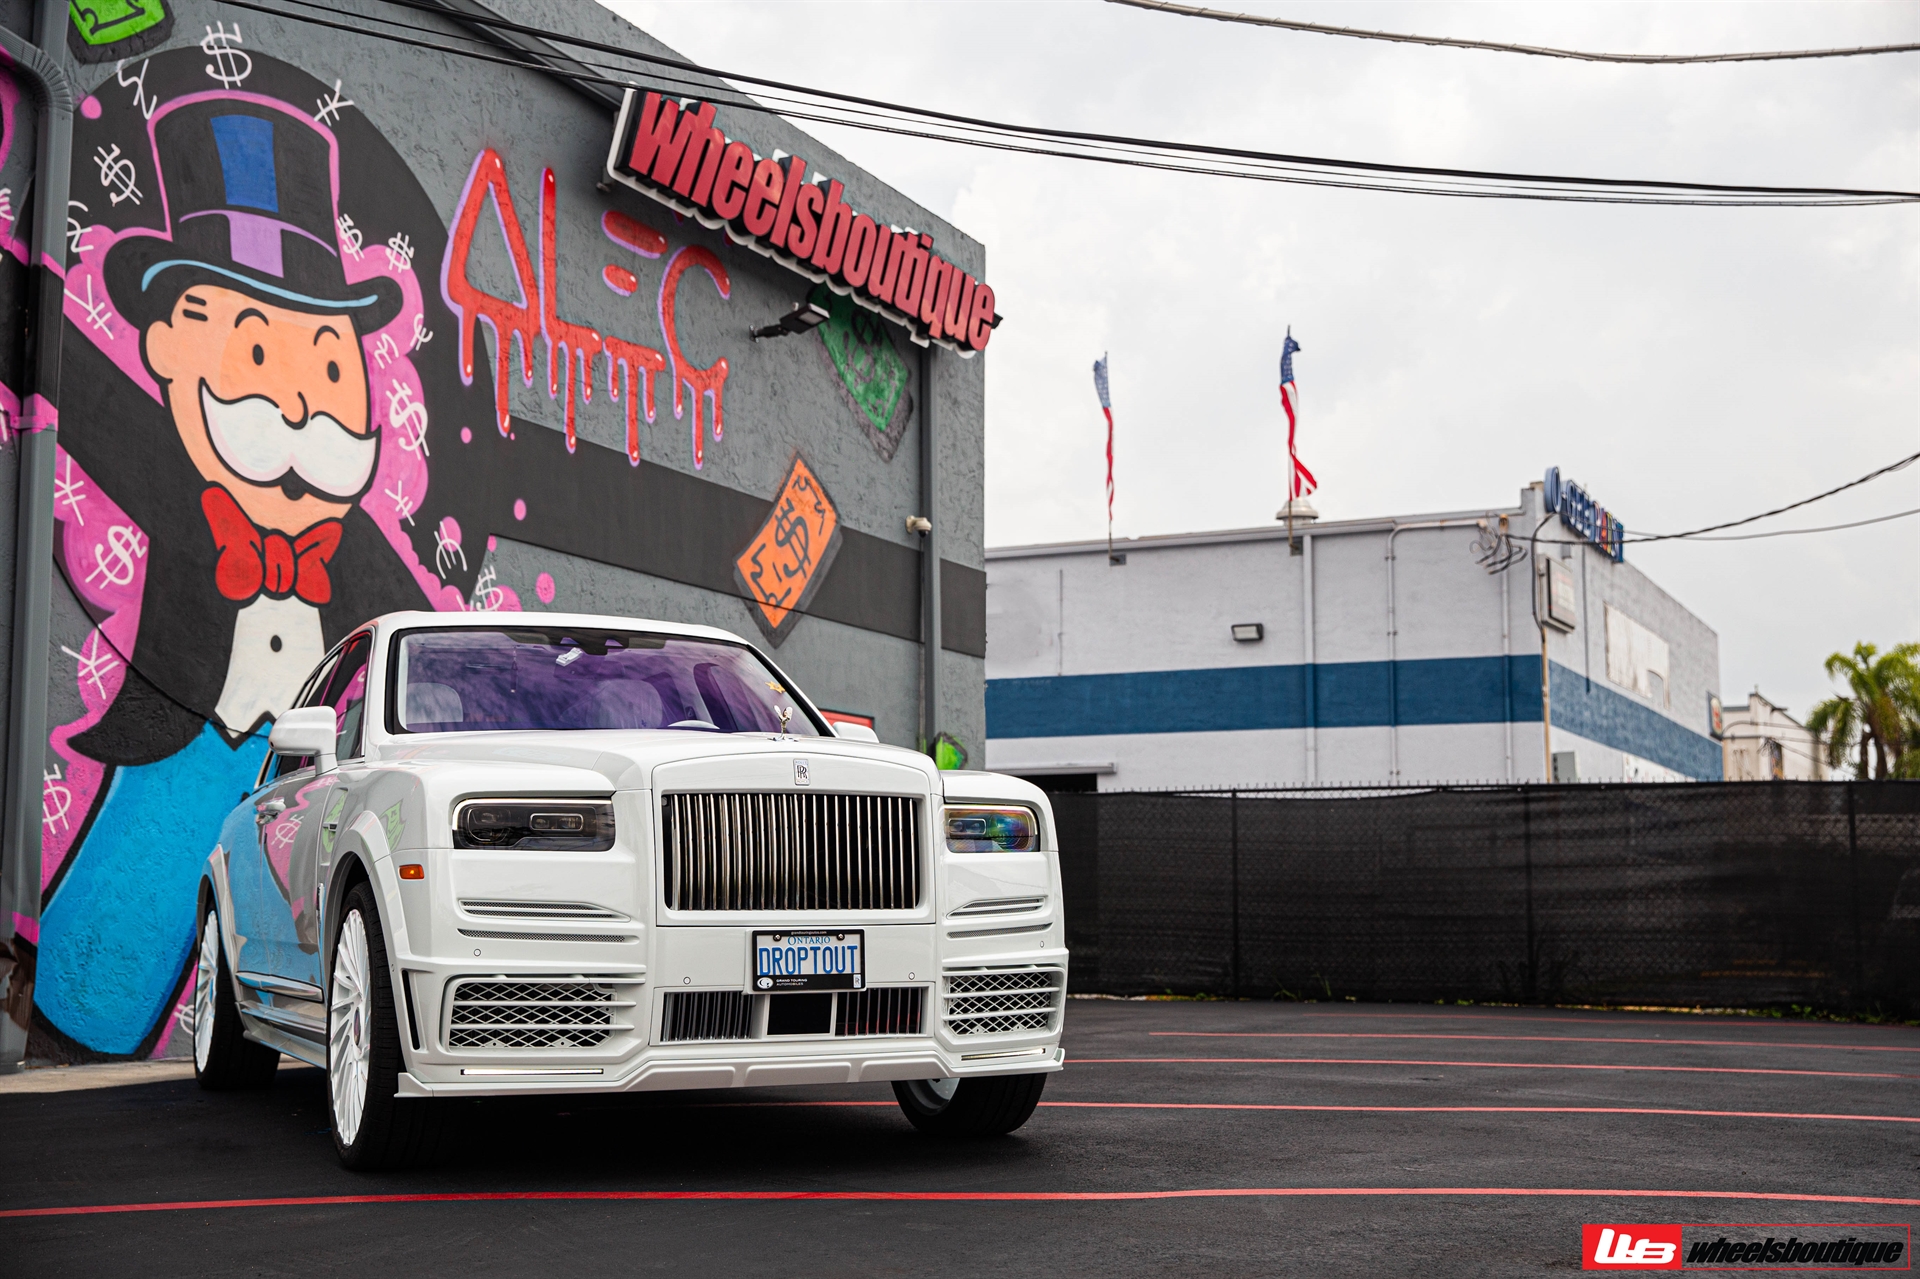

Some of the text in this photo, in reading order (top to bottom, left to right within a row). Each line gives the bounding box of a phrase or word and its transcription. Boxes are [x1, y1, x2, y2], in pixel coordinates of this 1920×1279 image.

[627, 91, 997, 350] wheelsboutique
[787, 935, 831, 945] ONTARIO
[758, 945, 858, 976] DROPTOUT
